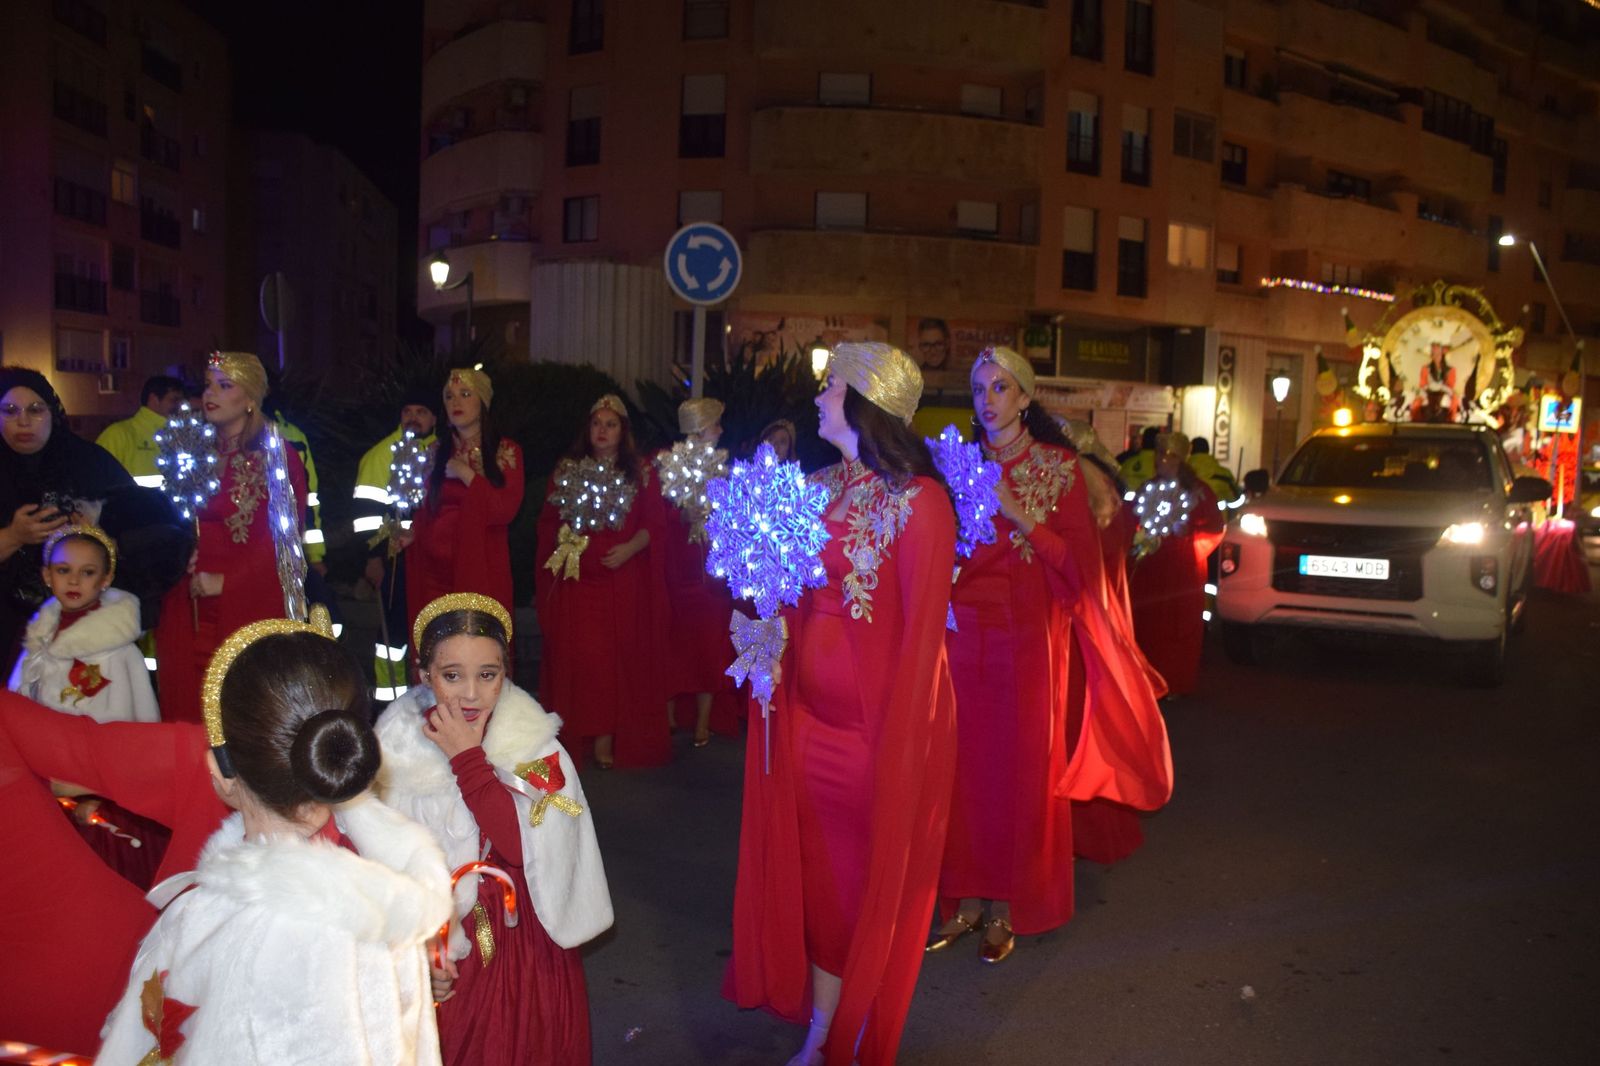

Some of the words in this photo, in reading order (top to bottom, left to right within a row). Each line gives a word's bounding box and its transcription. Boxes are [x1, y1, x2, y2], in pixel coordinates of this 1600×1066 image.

[1215, 350, 1233, 460] COACE
[1312, 560, 1349, 574] 6543
[1355, 562, 1385, 576] MDB
